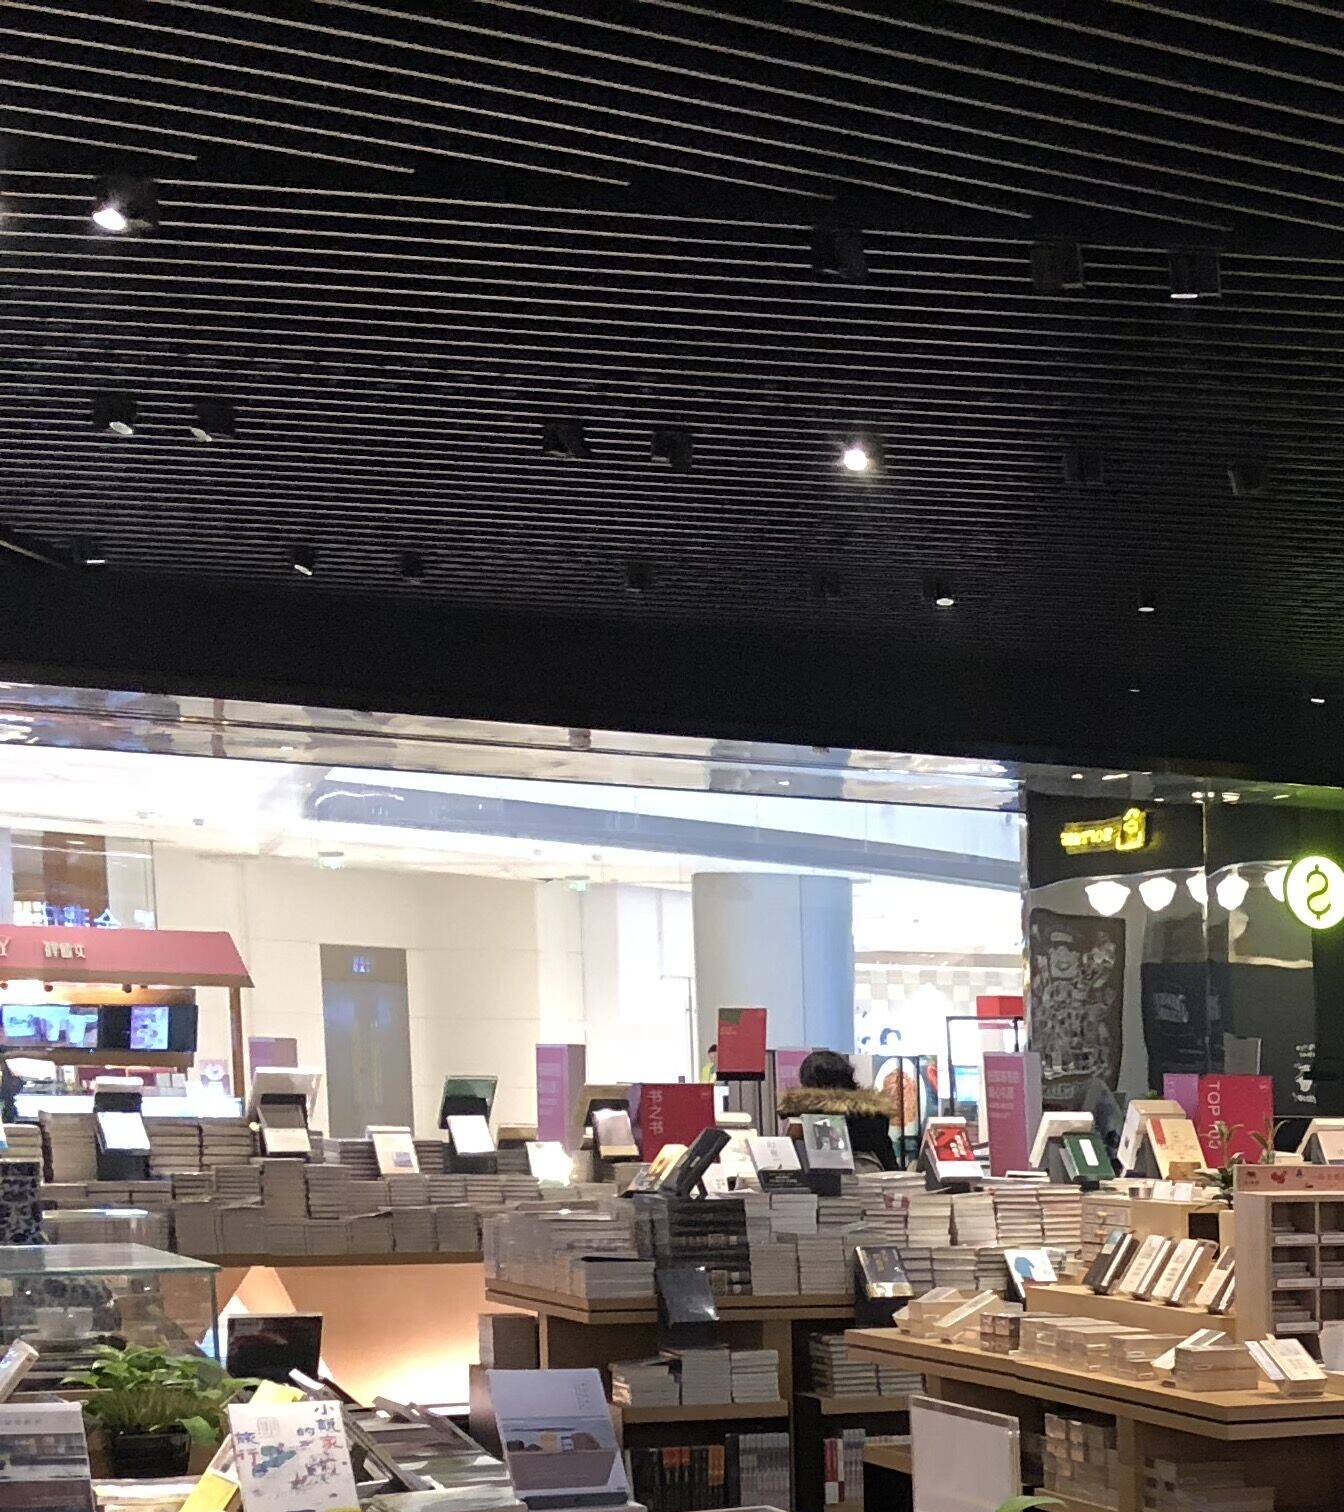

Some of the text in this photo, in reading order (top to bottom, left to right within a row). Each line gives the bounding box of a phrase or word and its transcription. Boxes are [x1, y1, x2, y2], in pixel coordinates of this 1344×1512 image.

[646, 1089, 664, 1136] 书之书
[1207, 1081, 1221, 1117] TOP
